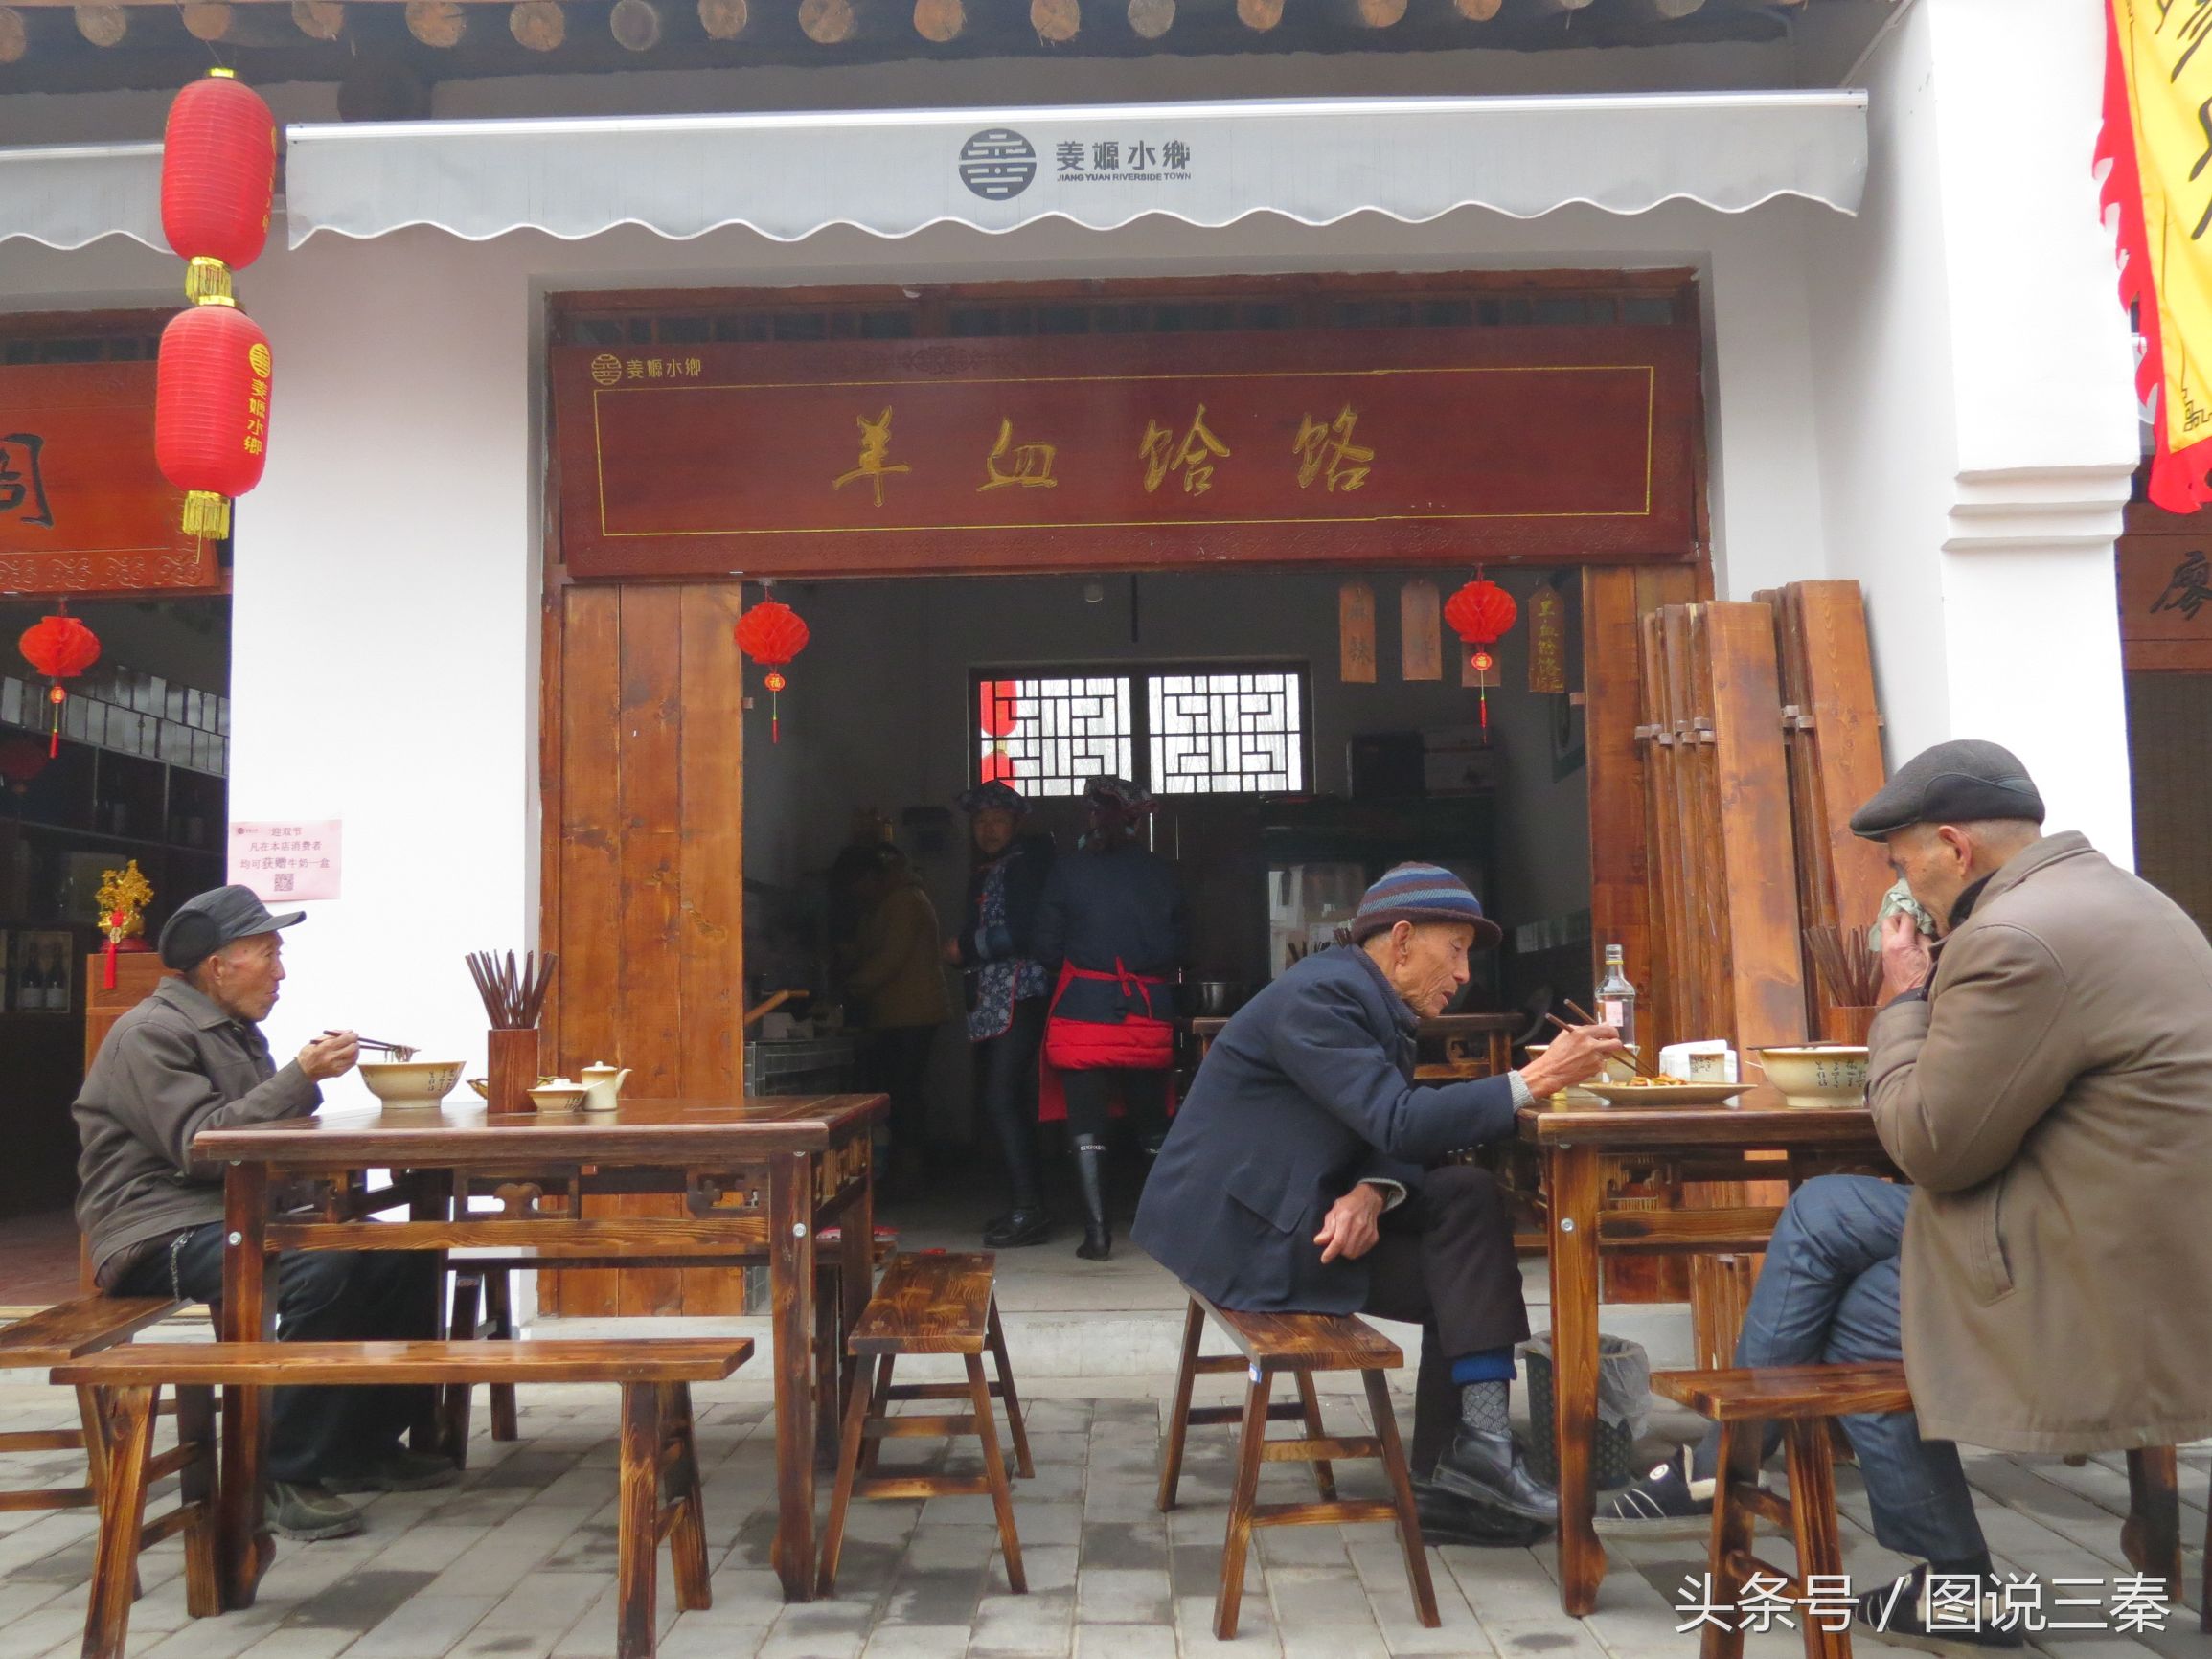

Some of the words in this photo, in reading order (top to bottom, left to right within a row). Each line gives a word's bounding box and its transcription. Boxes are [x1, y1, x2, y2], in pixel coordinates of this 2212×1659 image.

[1057, 173, 1084, 182] JIANG
[1084, 173, 1111, 182] YUAN
[1112, 172, 1162, 182] RIVERSIDE
[1164, 171, 1192, 181] TOWN
